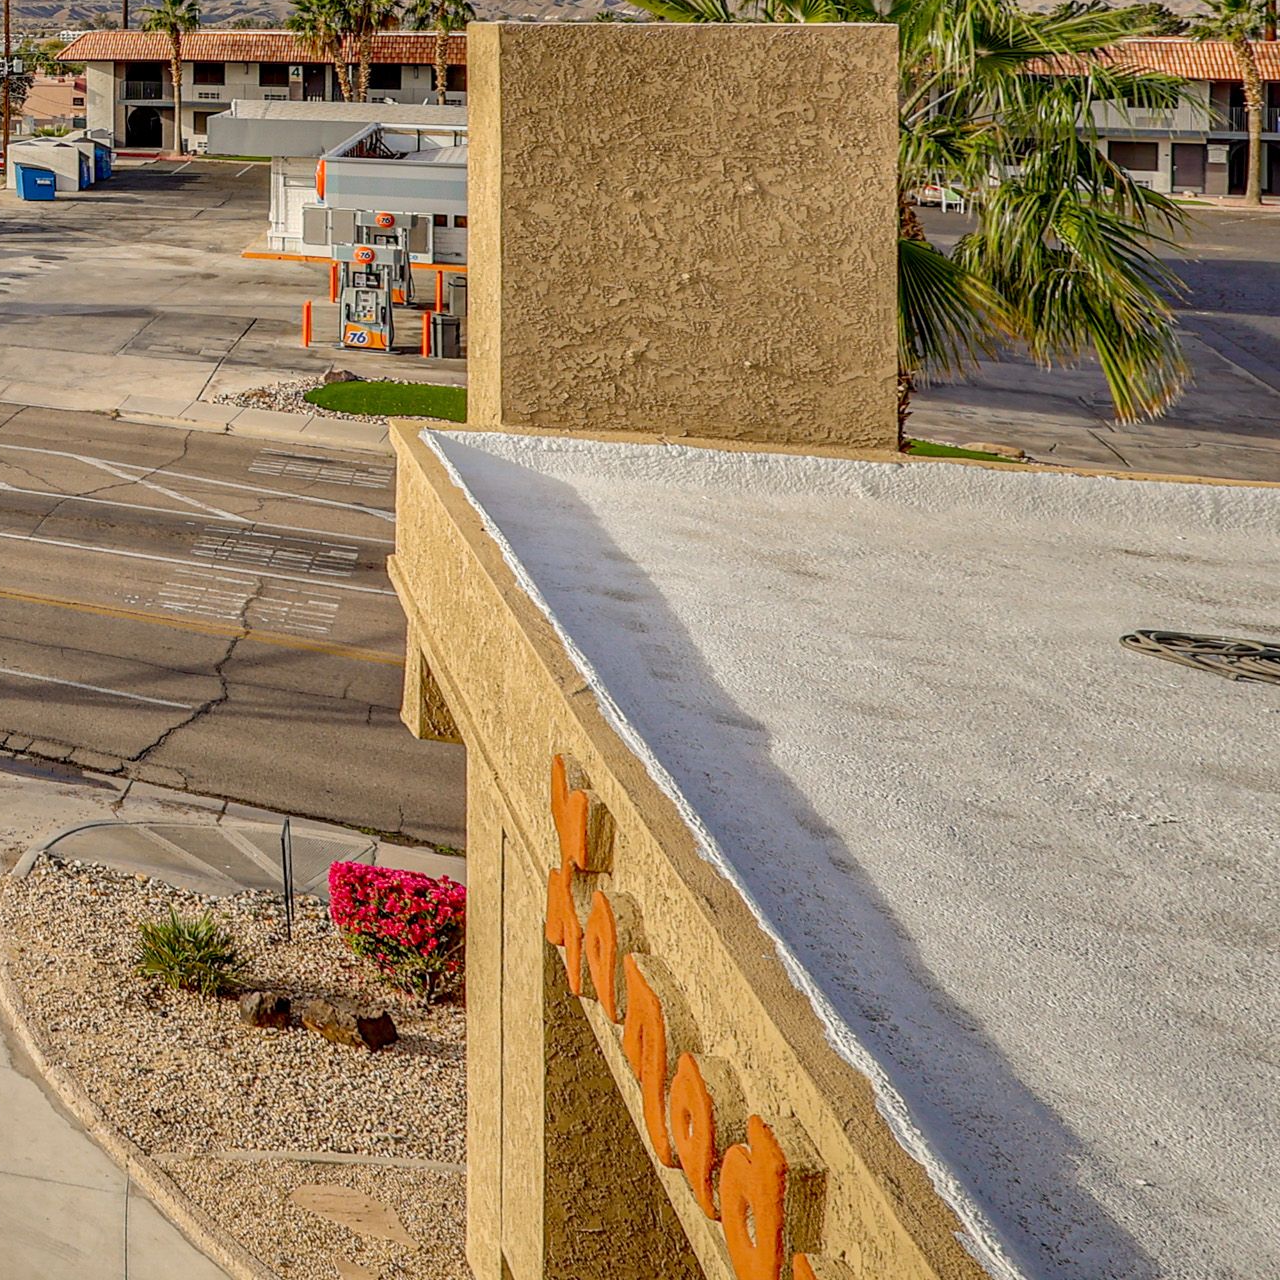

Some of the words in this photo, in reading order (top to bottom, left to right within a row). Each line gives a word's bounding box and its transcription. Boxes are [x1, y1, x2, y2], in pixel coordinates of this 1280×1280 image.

[291, 67, 300, 77] 4
[381, 216, 391, 224] 76
[349, 332, 366, 344] 76
[546, 753, 817, 1280] Xanad
